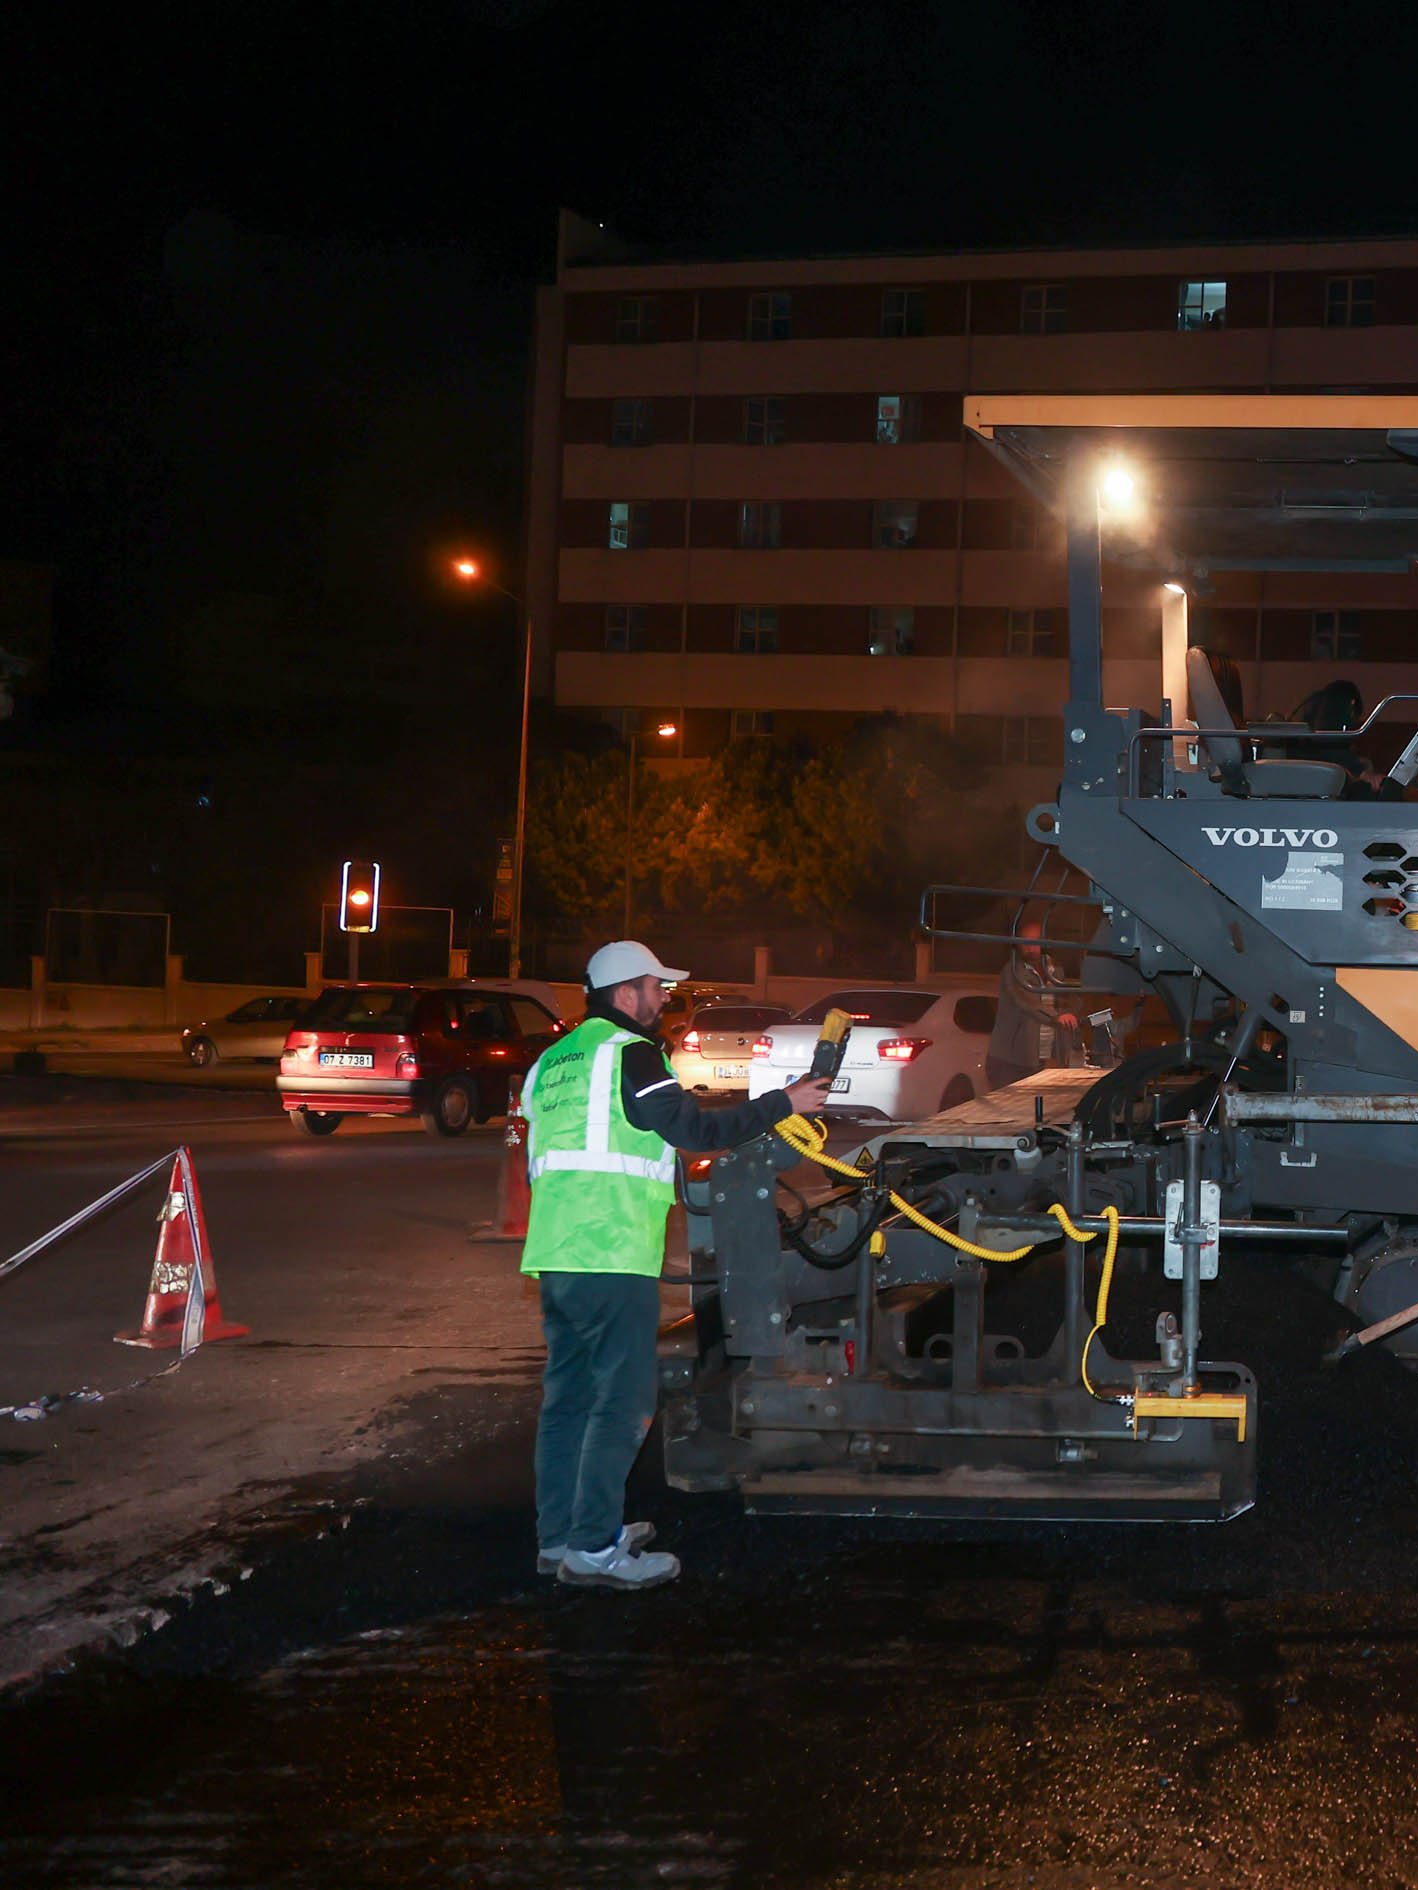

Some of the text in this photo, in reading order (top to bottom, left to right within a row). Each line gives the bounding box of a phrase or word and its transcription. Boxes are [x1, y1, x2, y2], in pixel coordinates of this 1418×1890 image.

[1201, 827, 1338, 848] VOLVO
[324, 1055, 370, 1066] 07 Z 7381
